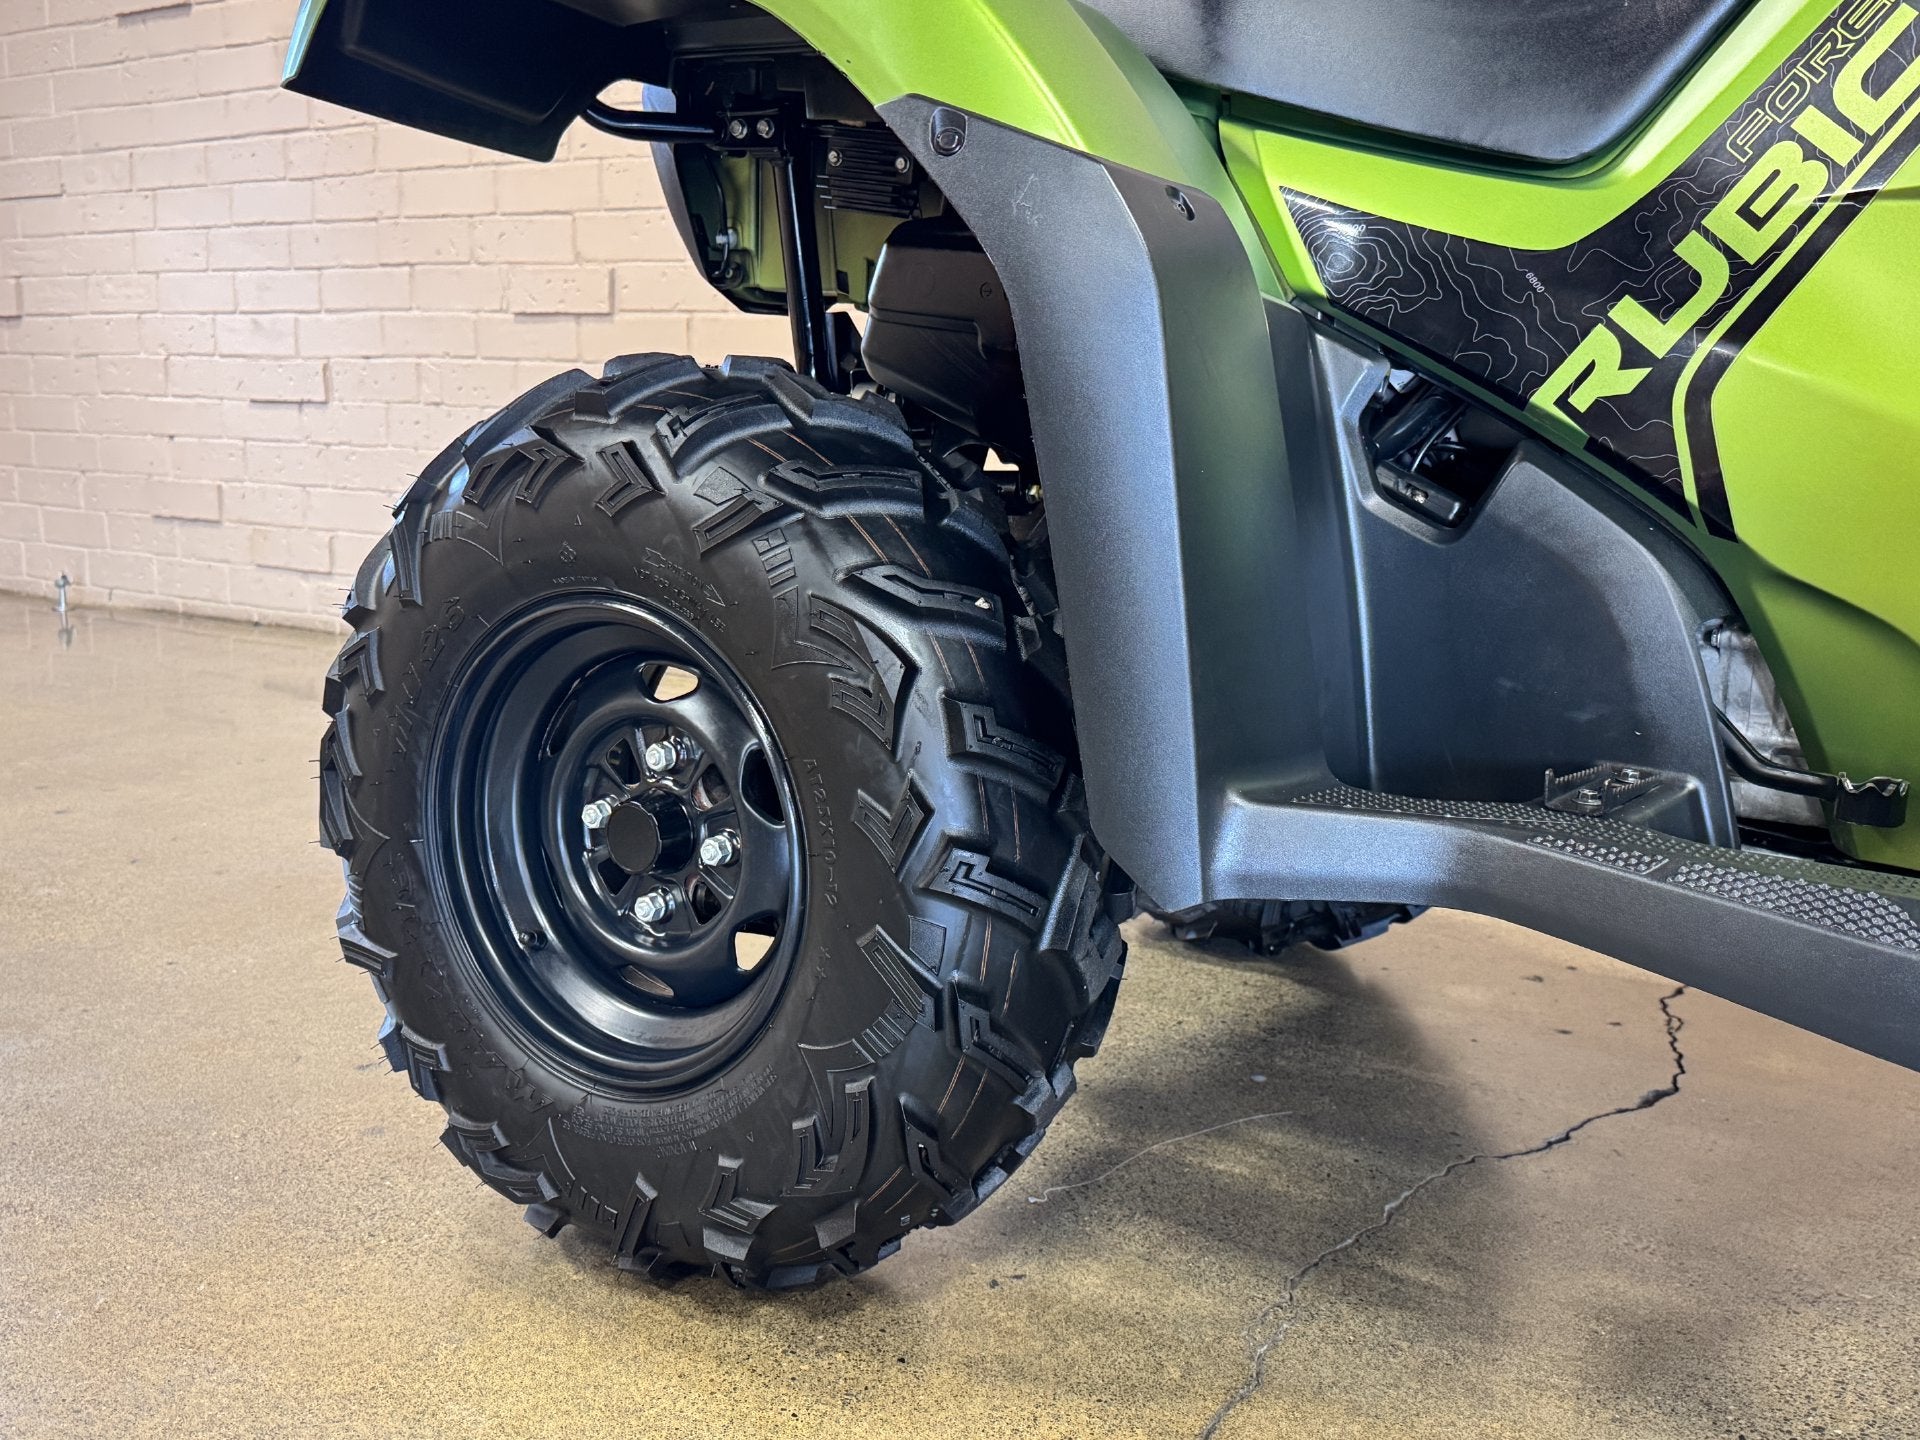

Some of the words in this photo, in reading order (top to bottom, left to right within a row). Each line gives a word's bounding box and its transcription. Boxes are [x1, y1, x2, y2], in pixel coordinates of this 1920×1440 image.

[1726, 0, 1898, 163] FORE
[1523, 2, 1920, 449] RUBIC
[1525, 272, 1546, 294] 6800
